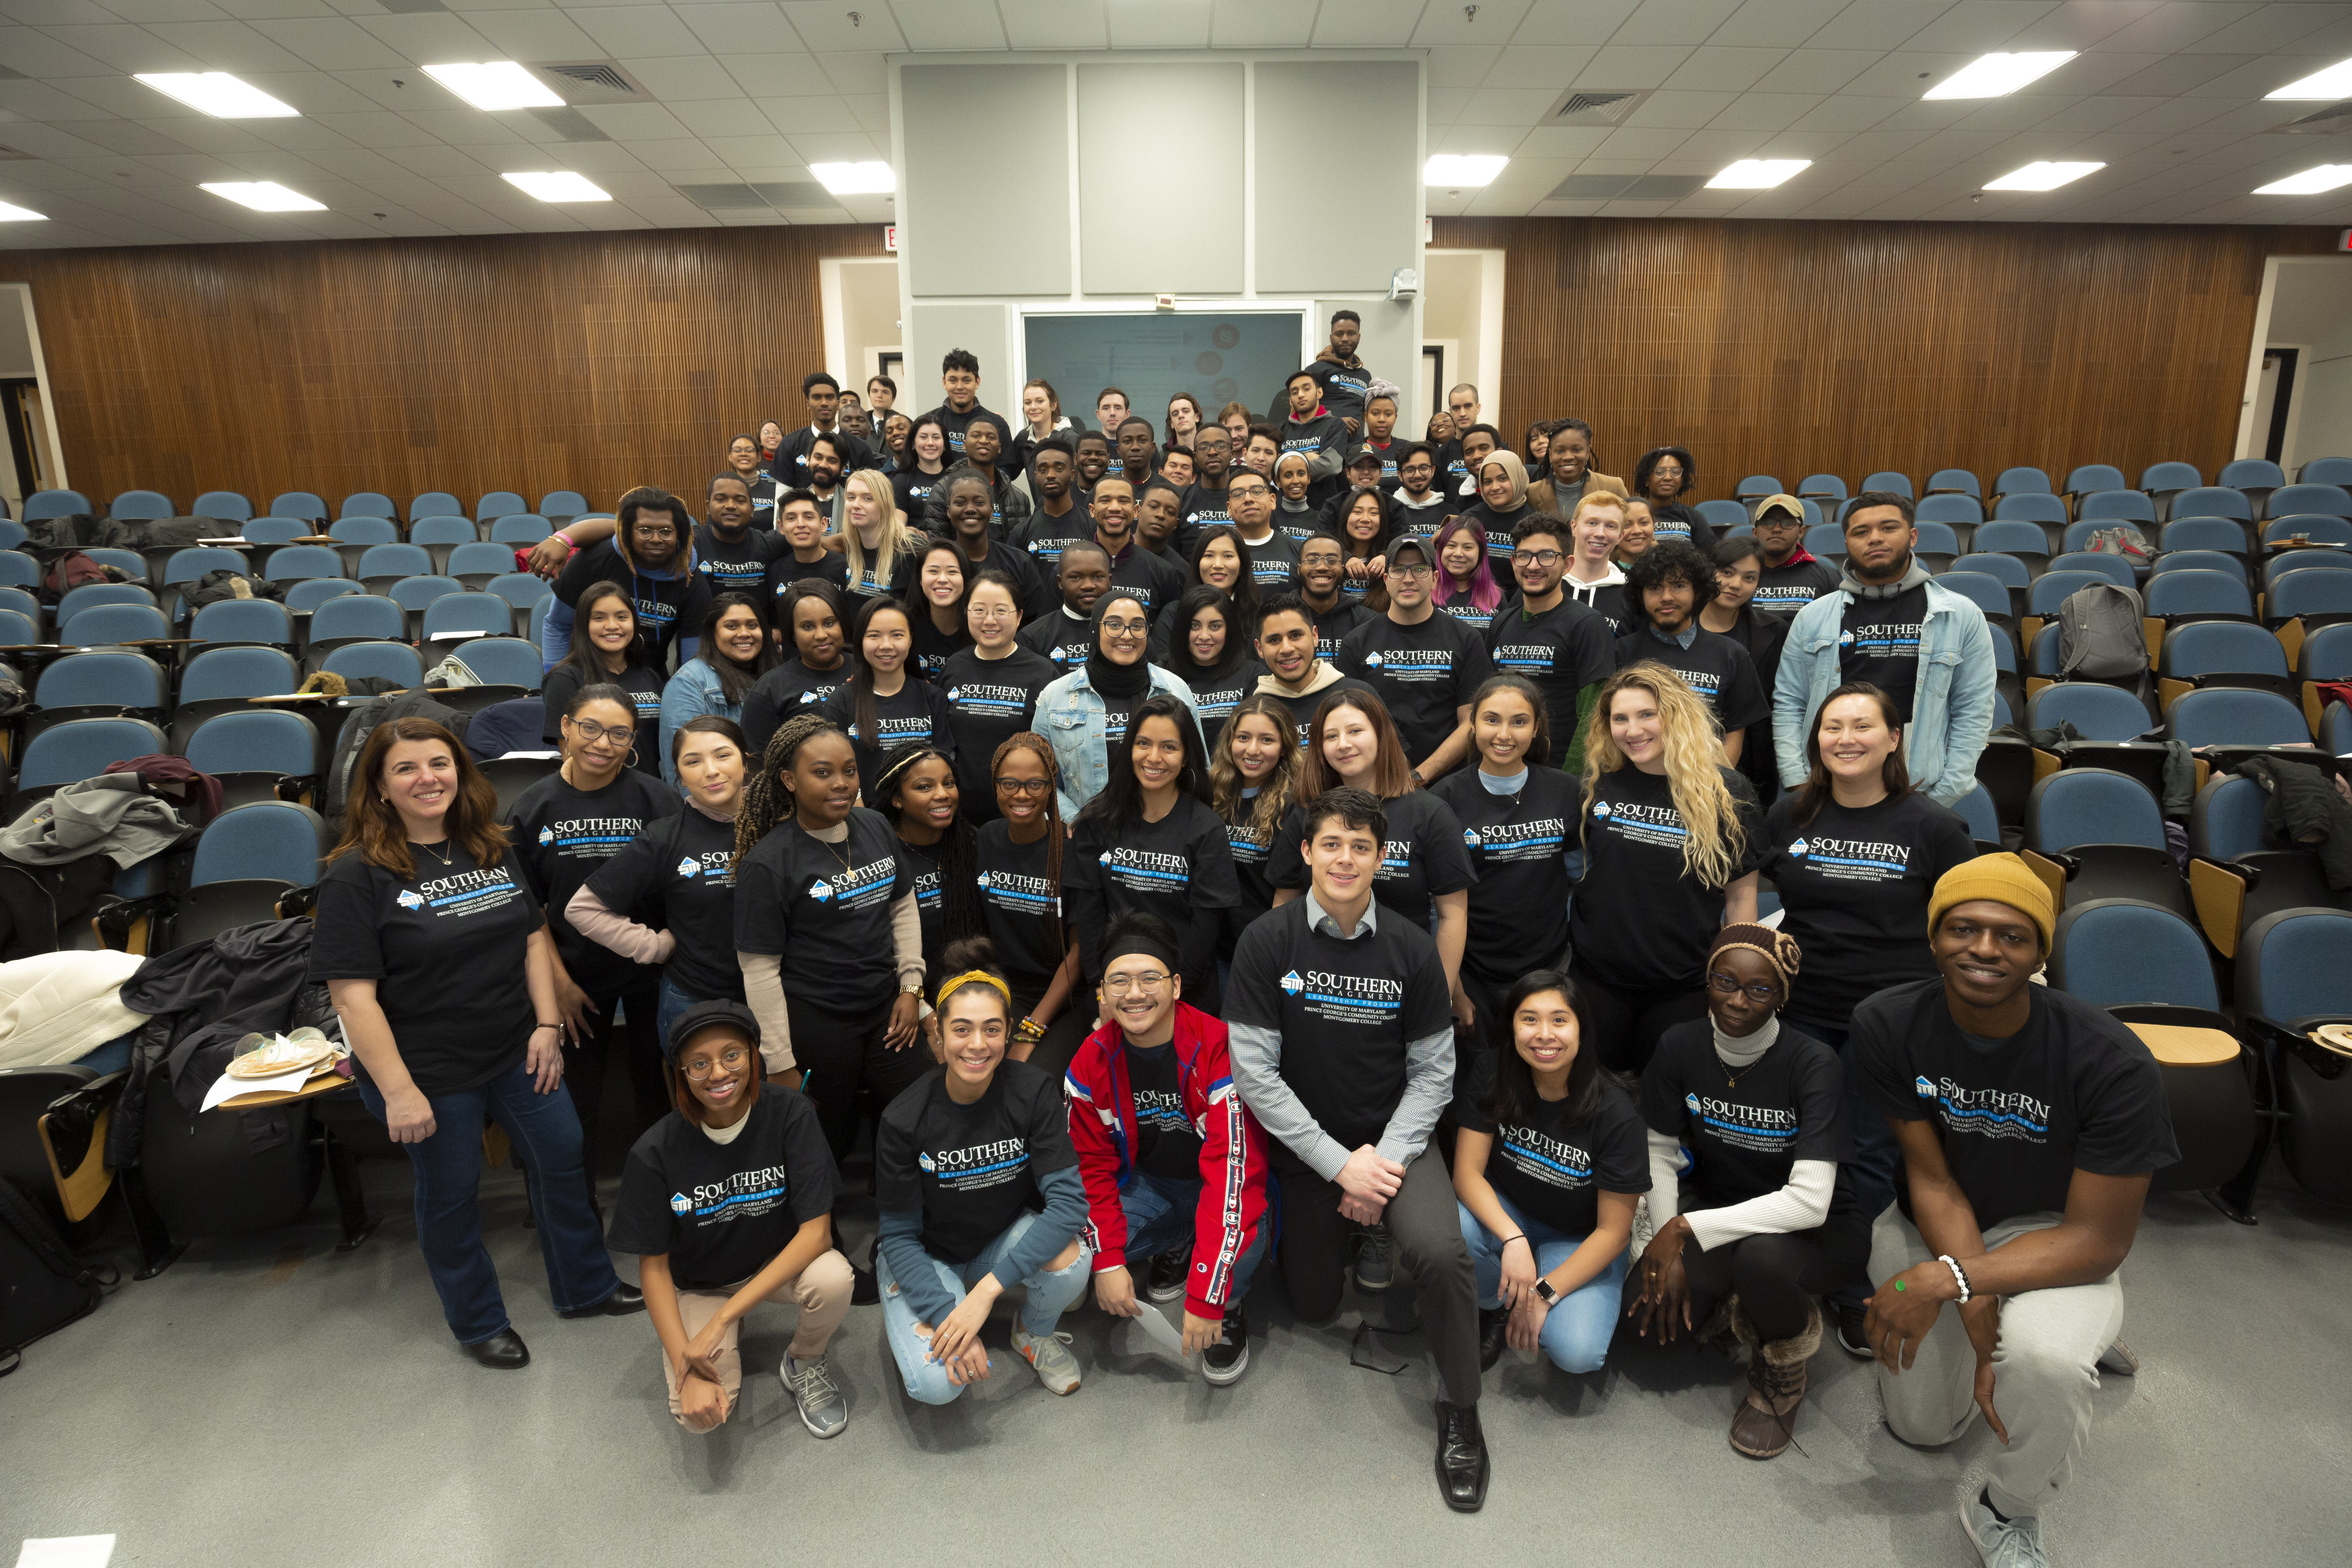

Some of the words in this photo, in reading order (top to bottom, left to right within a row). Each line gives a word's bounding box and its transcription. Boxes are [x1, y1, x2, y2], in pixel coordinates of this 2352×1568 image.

[1285, 437, 1321, 446] SOUTHERN
[714, 561, 765, 571] SOUTHERN
[1755, 587, 1816, 595] SOUTHERN
[1857, 624, 1922, 636] SOUTHER
[1384, 650, 1452, 660] SOUTHERN
[1502, 646, 1555, 656] SOUTHERN
[960, 694, 1026, 702] MANAGEMENT
[961, 684, 1028, 698] SOUTHERN
[555, 818, 642, 833] SOUTHERN
[1482, 818, 1564, 837] SOUTHERN
[1613, 817, 1658, 829] LEADERSHIP
[1483, 830, 1565, 843] MANAGEMENT
[1623, 834, 1658, 844] MONTGOMERY
[1811, 837, 1911, 859] SOUTHERN
[1114, 848, 1188, 869] SOUTHERN
[1810, 849, 1907, 865] MANAGEMENT
[1863, 860, 1903, 870] PROGRAM
[832, 855, 895, 887] SOUTHERN
[1113, 859, 1188, 875] MANAGEMENT
[1114, 866, 1152, 875] LEADERSHIP
[420, 866, 509, 896] SOUTHERN
[427, 878, 511, 901] MANAGEMENT
[433, 892, 479, 906] LEADERSHIP
[483, 884, 514, 892] PROGRAM
[840, 884, 876, 898] LEADERSHIP
[990, 889, 1025, 897] LEADERSHIP
[437, 909, 454, 917] PRINCE
[477, 895, 506, 907] COMMUNITY
[449, 900, 477, 909] UNIVERSITY
[483, 891, 508, 900] MARYLAND
[457, 906, 490, 917] MONTGOMERY
[491, 898, 512, 907] COLLEGE
[1307, 971, 1402, 994] SOUTHERN
[1306, 986, 1401, 1000] MANAGEMENT
[1308, 994, 1358, 1004] LEADERSHIP
[1323, 1015, 1359, 1023] MONTGOMERY
[1940, 1077, 2051, 1119] SOUTHERN
[1703, 1097, 1796, 1123] SOUTHERN
[1941, 1089, 2048, 1125] MANAGEMENT
[1704, 1110, 1797, 1129] MANAGEMENT
[1706, 1118, 1753, 1133] LEADERSHIP
[1949, 1114, 1985, 1123] UNIVERSITY
[1993, 1121, 2026, 1132] MARYLAND
[2000, 1114, 2043, 1131] PROGRAM
[1233, 1115, 1243, 1155] Champion
[1719, 1128, 1747, 1138] UNIVERSITY
[1952, 1127, 1996, 1139] MONTGOMERY
[1997, 1132, 2022, 1140] COLLEGE
[1983, 1124, 2018, 1134] COMMUNITY
[2019, 1131, 2047, 1143] COLLEGE
[938, 1137, 1025, 1165] SOUTHERN
[1508, 1124, 1590, 1166] SOUTHERN
[938, 1150, 1023, 1171] MANAGEMEN
[1507, 1143, 1552, 1164] LEADERSHIP
[1556, 1164, 1590, 1176] PROGRAM
[941, 1166, 991, 1178] LEADERSHIP
[983, 1172, 1012, 1182] COMMUNITY
[992, 1165, 1018, 1176] MARYLAND
[694, 1165, 784, 1200] SOUTHERN
[959, 1181, 995, 1191] MONTGOMERY
[996, 1175, 1016, 1184] COLLEGE
[1229, 1168, 1241, 1208] Champion
[746, 1188, 784, 1200] PROGRAM
[1209, 1266, 1227, 1304] Champion
